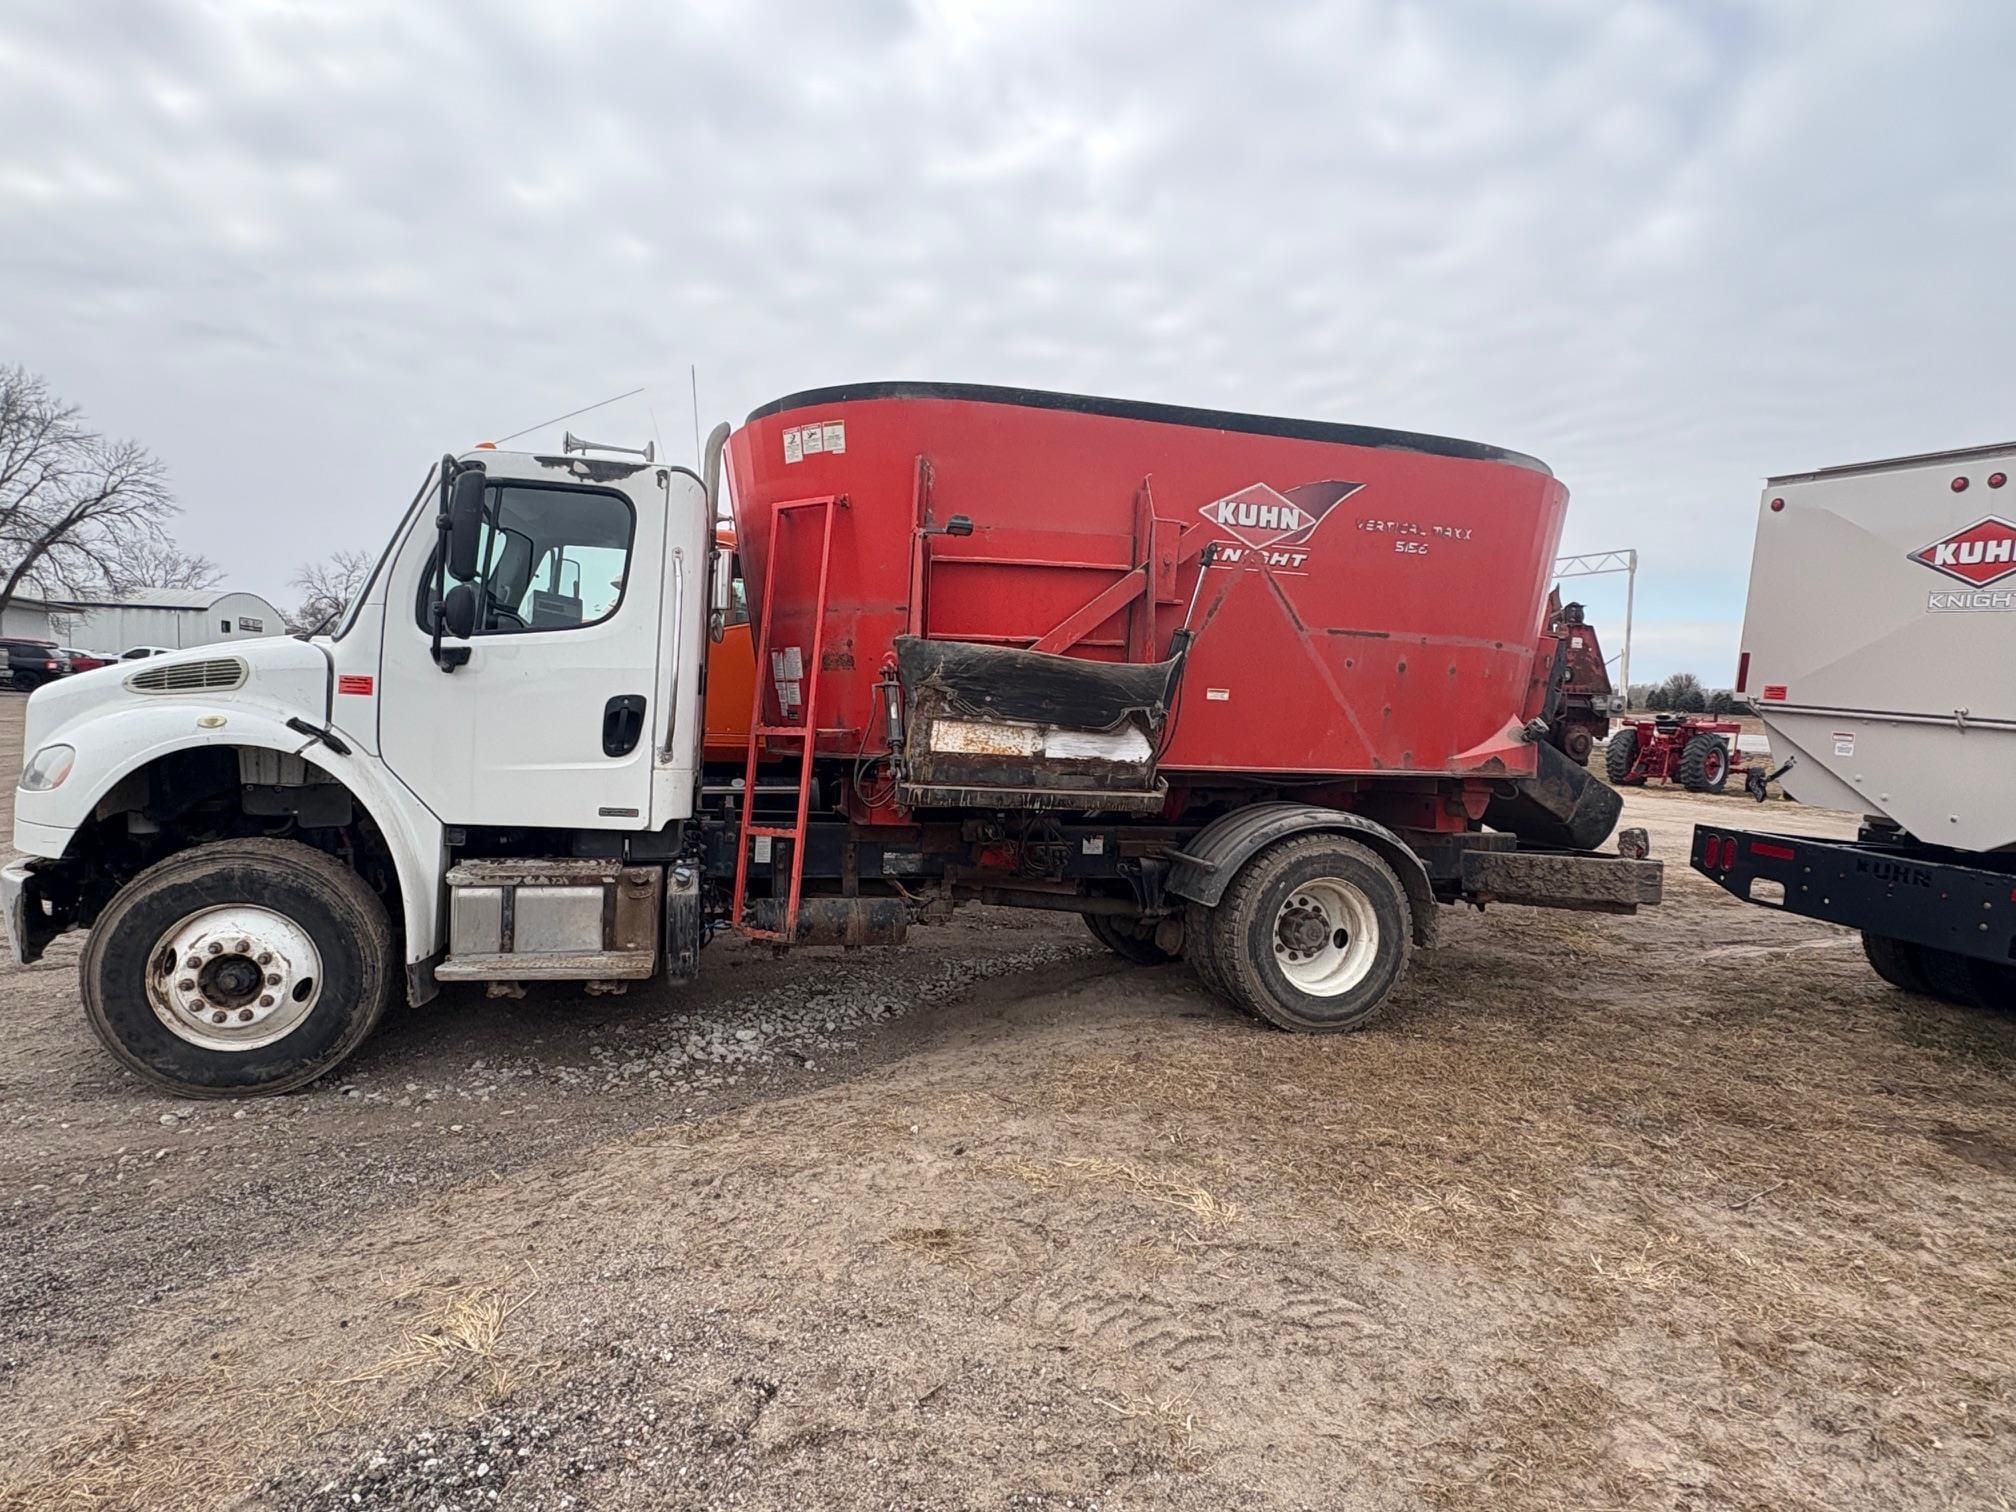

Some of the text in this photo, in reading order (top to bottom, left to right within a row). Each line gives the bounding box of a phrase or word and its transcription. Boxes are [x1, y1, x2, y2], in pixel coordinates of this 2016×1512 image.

[1217, 501, 1301, 531] KUHN
[1210, 546, 1308, 568] NGHT
[1934, 539, 2016, 565] KUH
[1928, 593, 2016, 608] KNIGH
[1856, 859, 1933, 888] KUHN
